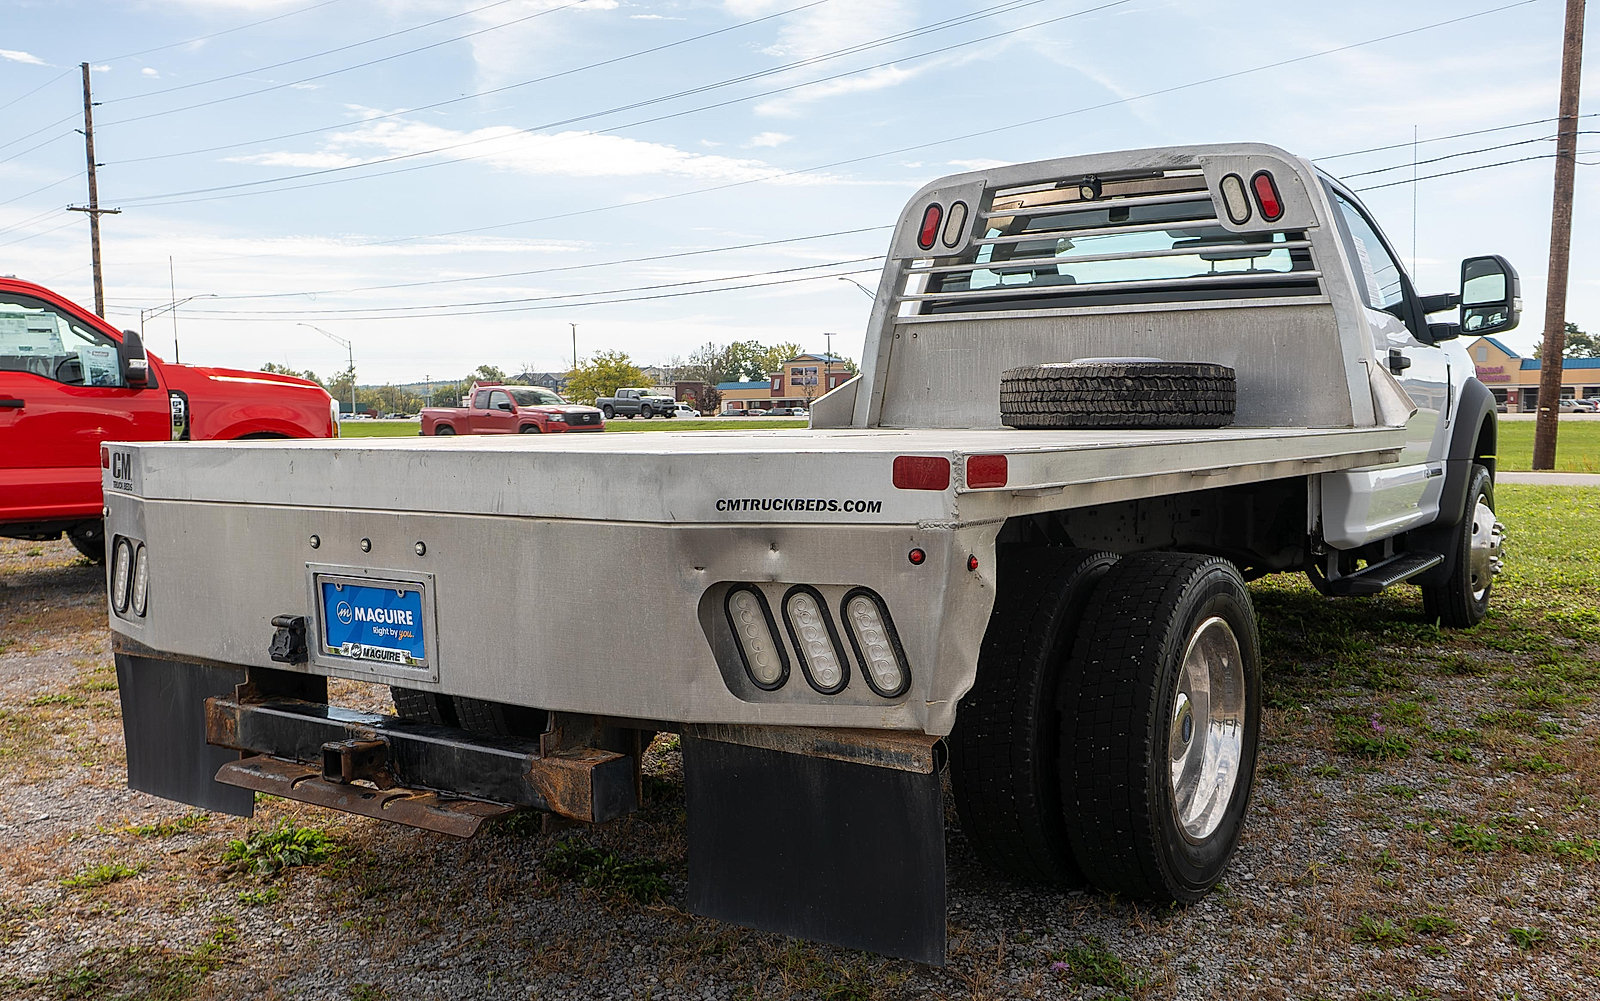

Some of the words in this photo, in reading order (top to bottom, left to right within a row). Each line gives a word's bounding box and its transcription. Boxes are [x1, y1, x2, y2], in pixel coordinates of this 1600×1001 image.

[113, 452, 131, 480] CM
[715, 499, 882, 513] CMTRUCKBEDS.COM
[354, 606, 414, 625] MAGUIRE
[373, 626, 389, 637] Right
[390, 628, 398, 638] by
[399, 631, 414, 641] you.
[362, 648, 401, 661] MAGUIRE
